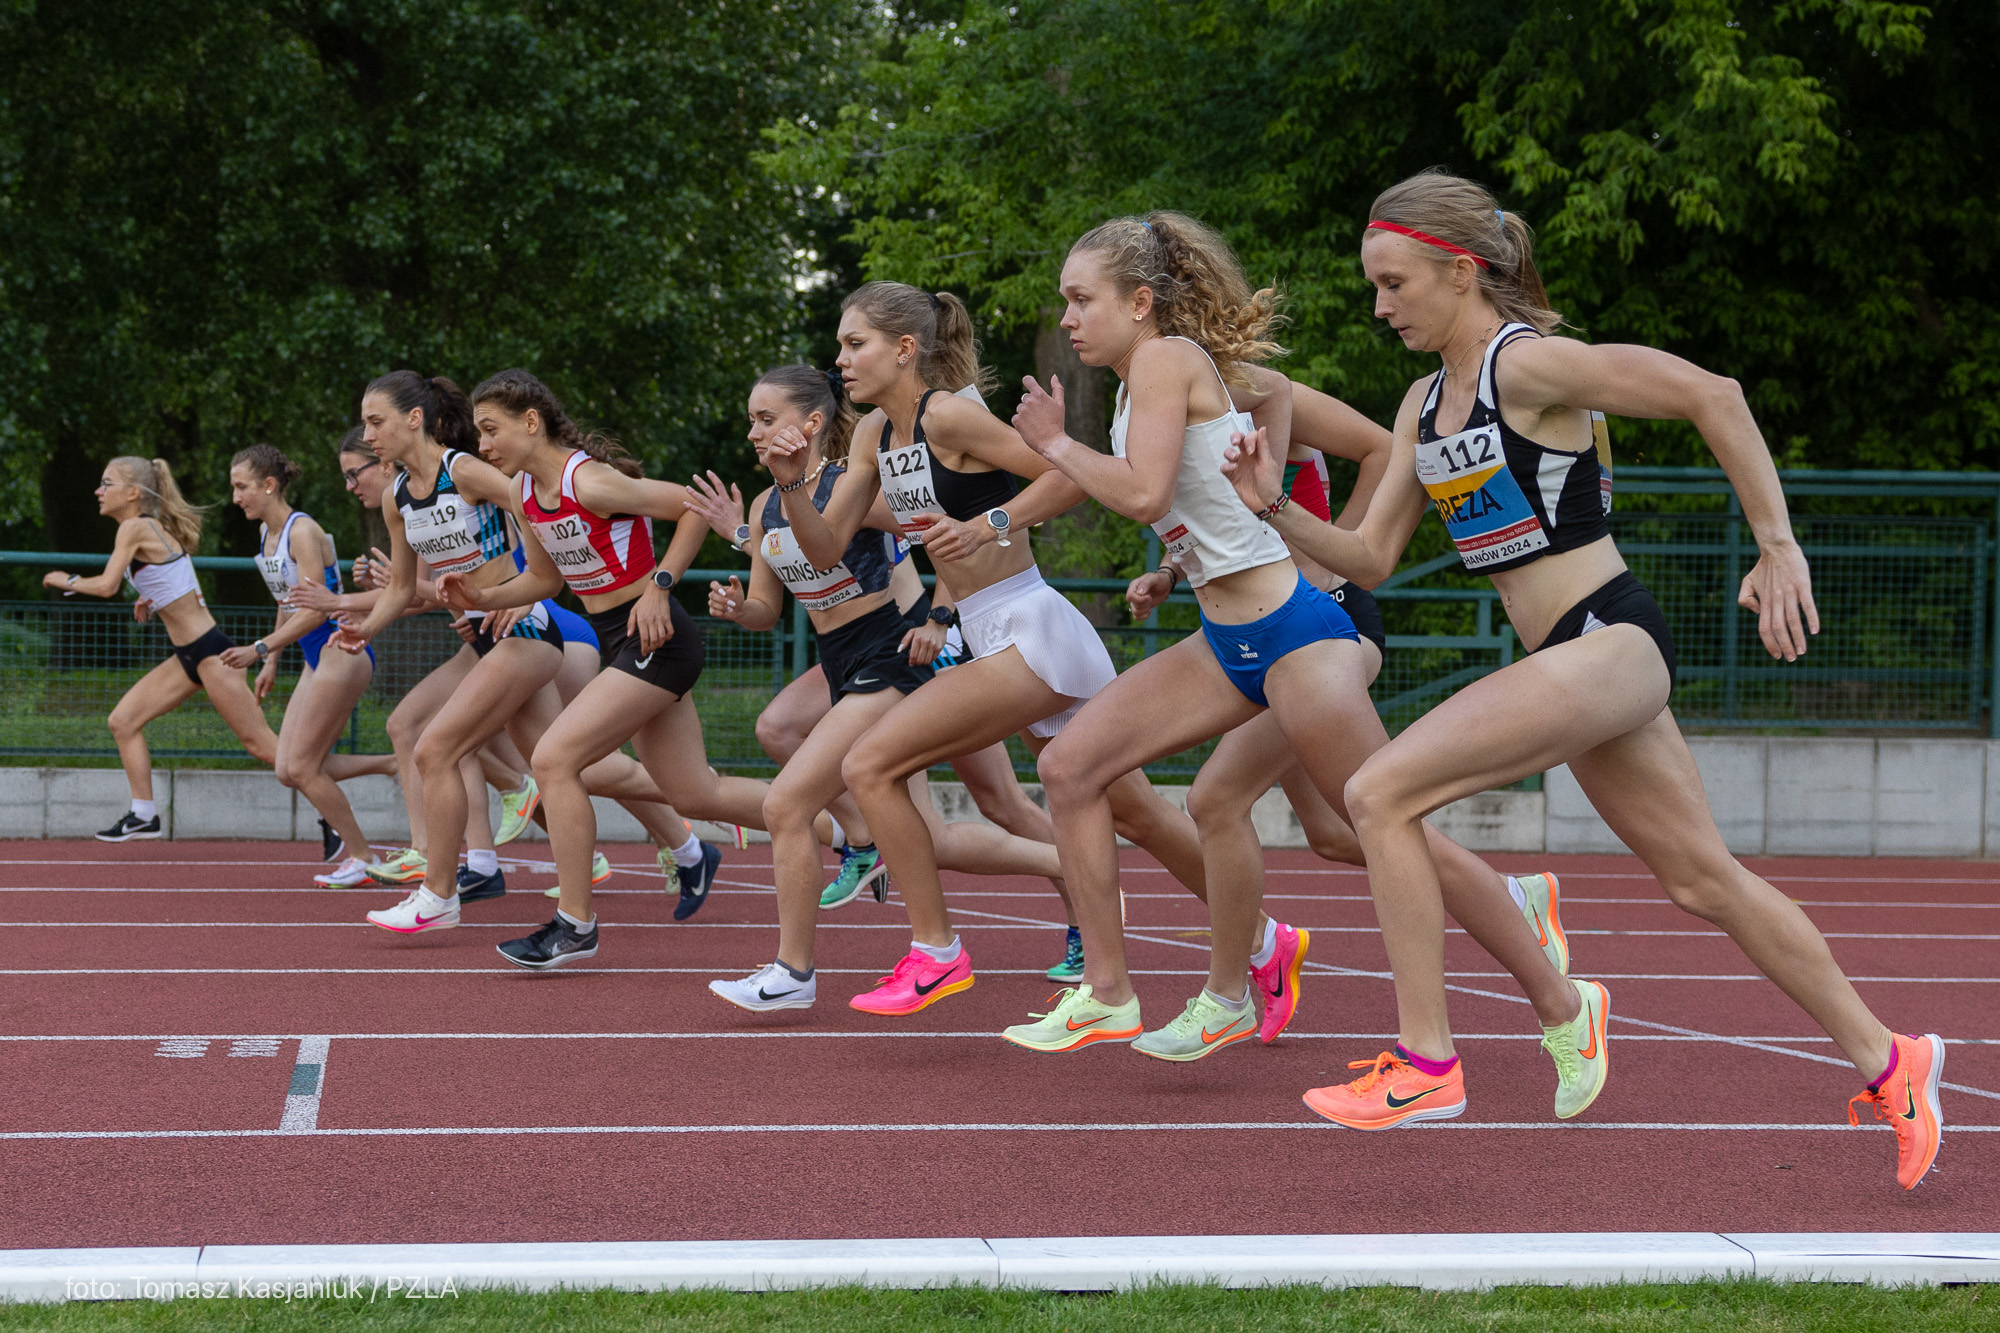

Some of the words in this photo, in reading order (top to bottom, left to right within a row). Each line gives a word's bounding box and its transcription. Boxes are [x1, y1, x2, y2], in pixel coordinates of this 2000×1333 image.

[885, 449, 925, 478] 122
[1440, 433, 1497, 474] 112
[430, 505, 456, 526] 119
[550, 519, 581, 540] 102
[1514, 525, 1529, 535] 5000
[411, 528, 472, 556] PAWEŁCZYK
[1500, 538, 1531, 557] 2024
[265, 559, 279, 573] 115
[829, 589, 851, 604] 2024
